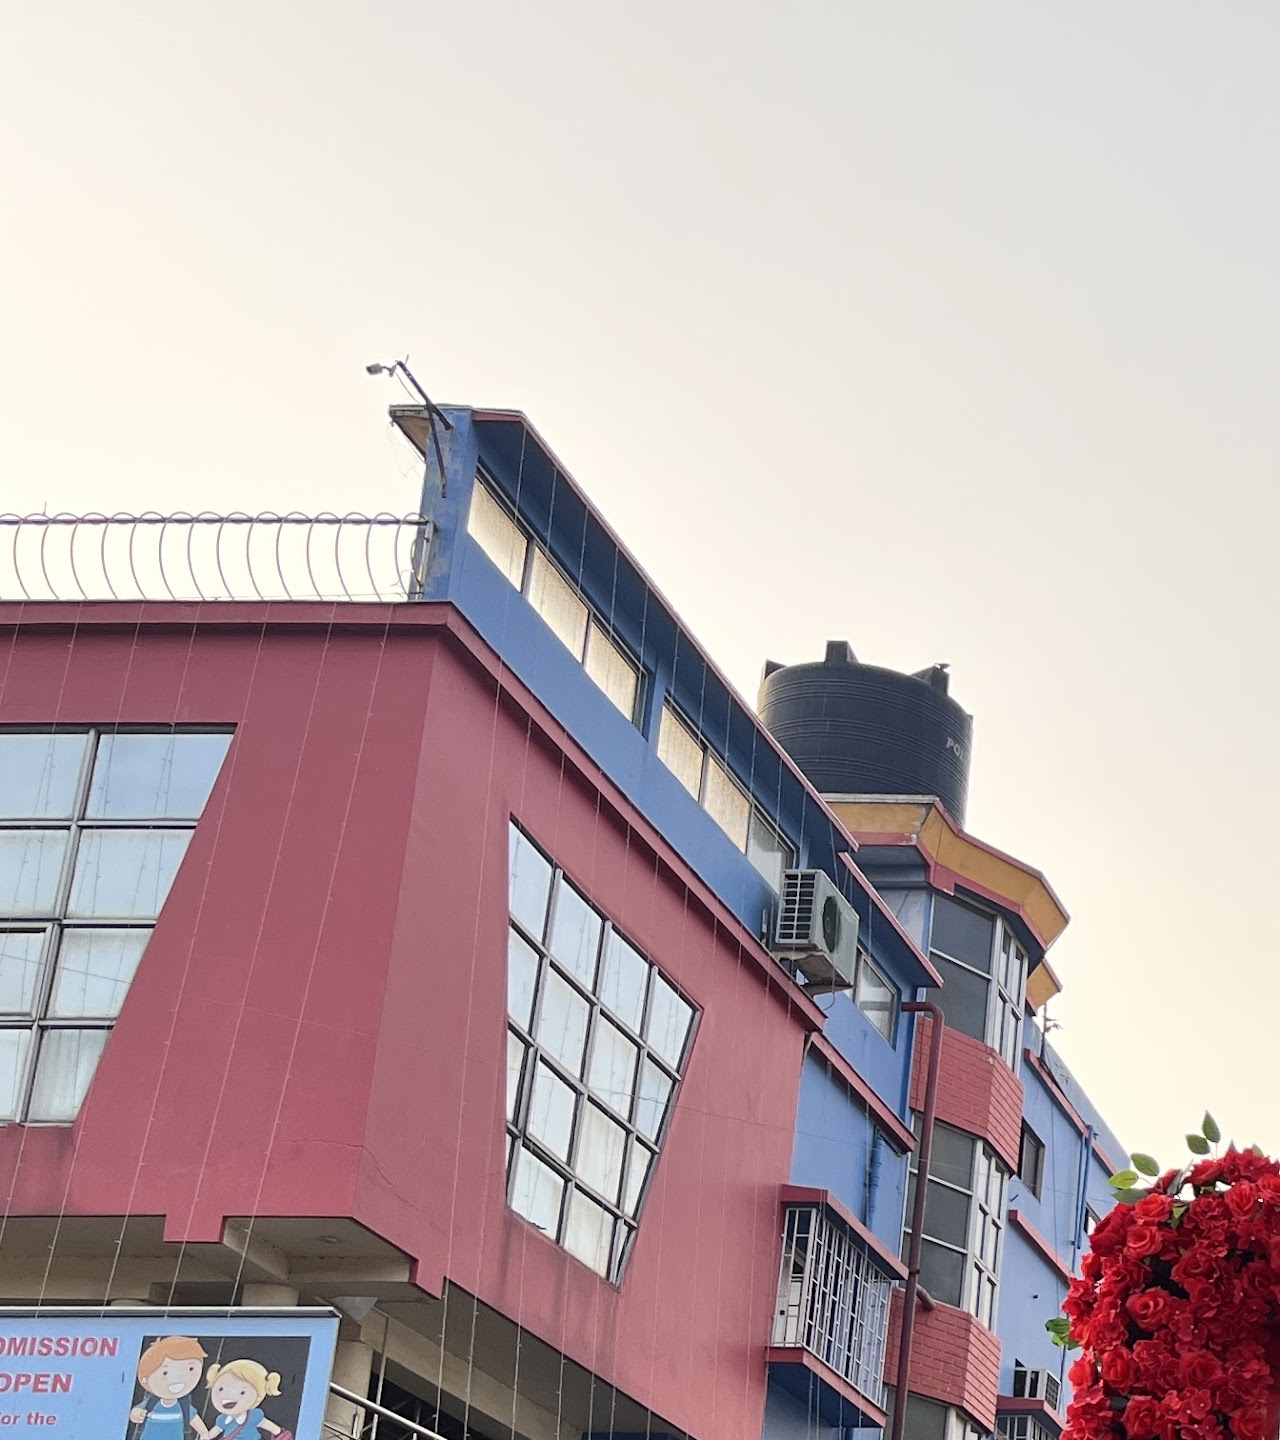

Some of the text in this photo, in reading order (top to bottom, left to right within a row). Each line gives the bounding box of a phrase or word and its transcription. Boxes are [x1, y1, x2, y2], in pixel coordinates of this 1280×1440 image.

[0, 1373, 72, 1393] OPEN
[0, 1412, 57, 1425] or the
